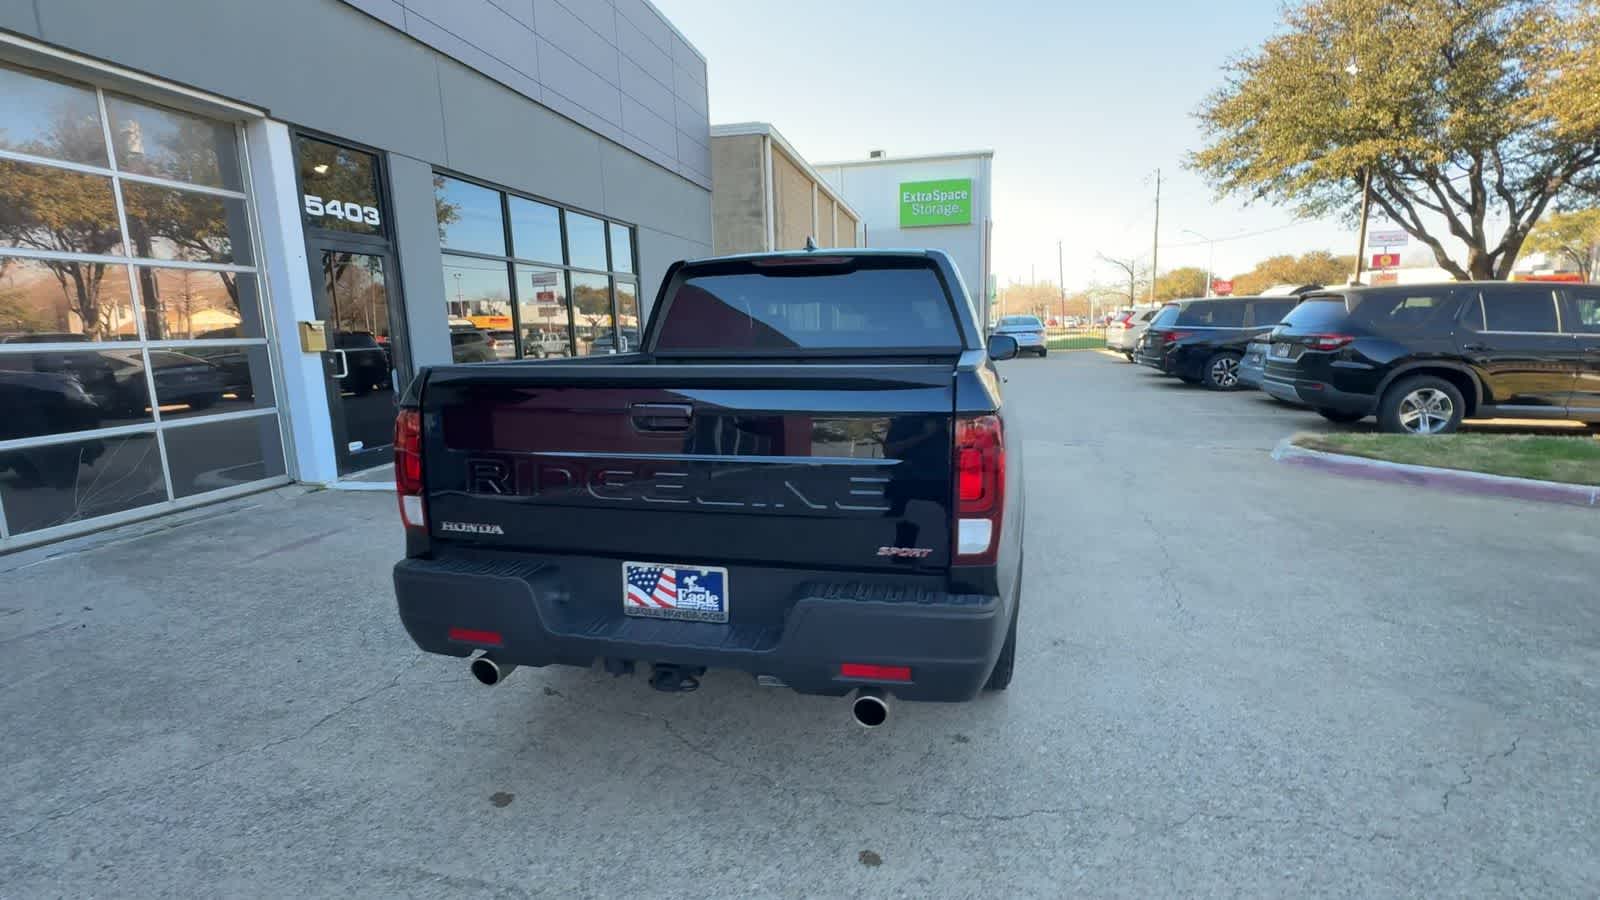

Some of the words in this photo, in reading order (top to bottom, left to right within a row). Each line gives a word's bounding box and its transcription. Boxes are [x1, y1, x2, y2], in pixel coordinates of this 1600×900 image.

[304, 194, 380, 225] 5403
[440, 521, 504, 535] HONDA
[876, 546, 934, 558] SPORT
[676, 588, 719, 608] Eagle
